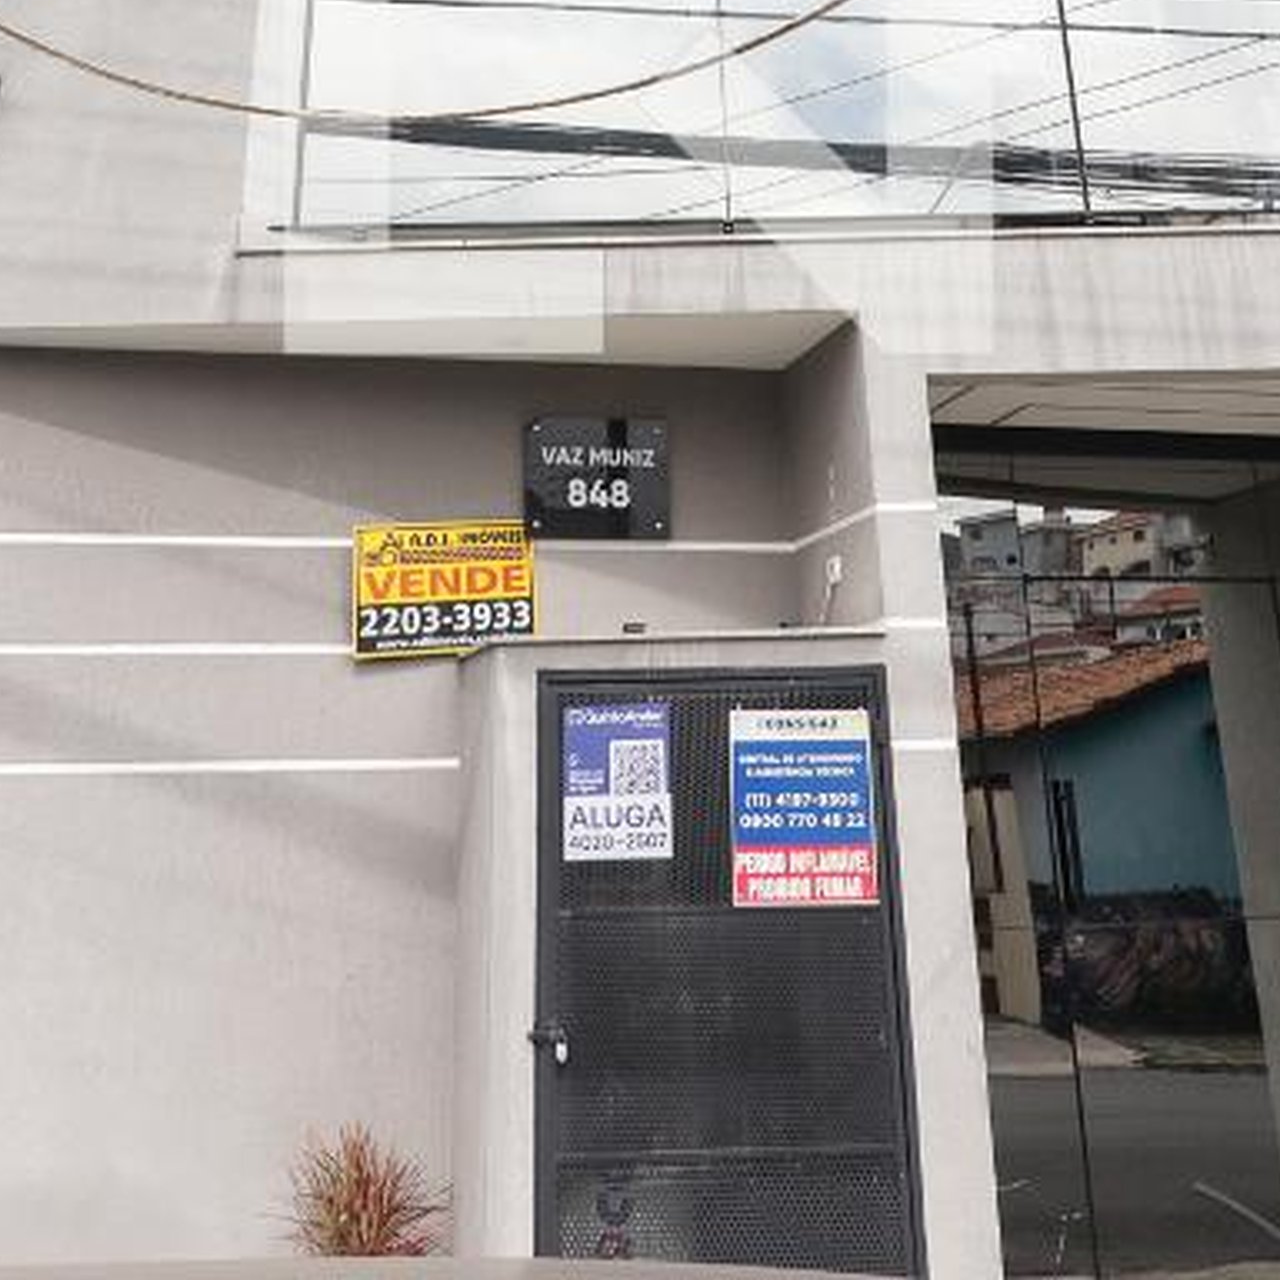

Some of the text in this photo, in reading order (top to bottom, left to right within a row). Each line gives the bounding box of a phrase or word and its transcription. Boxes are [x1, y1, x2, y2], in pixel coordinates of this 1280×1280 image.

[541, 445, 656, 469] VAZ MUNIZ
[567, 477, 631, 508] 848
[364, 565, 528, 601] VENDE
[359, 599, 532, 638] 2203-3933
[569, 803, 667, 830] ALUGA
[786, 812, 818, 828] 770
[845, 812, 867, 828] 22
